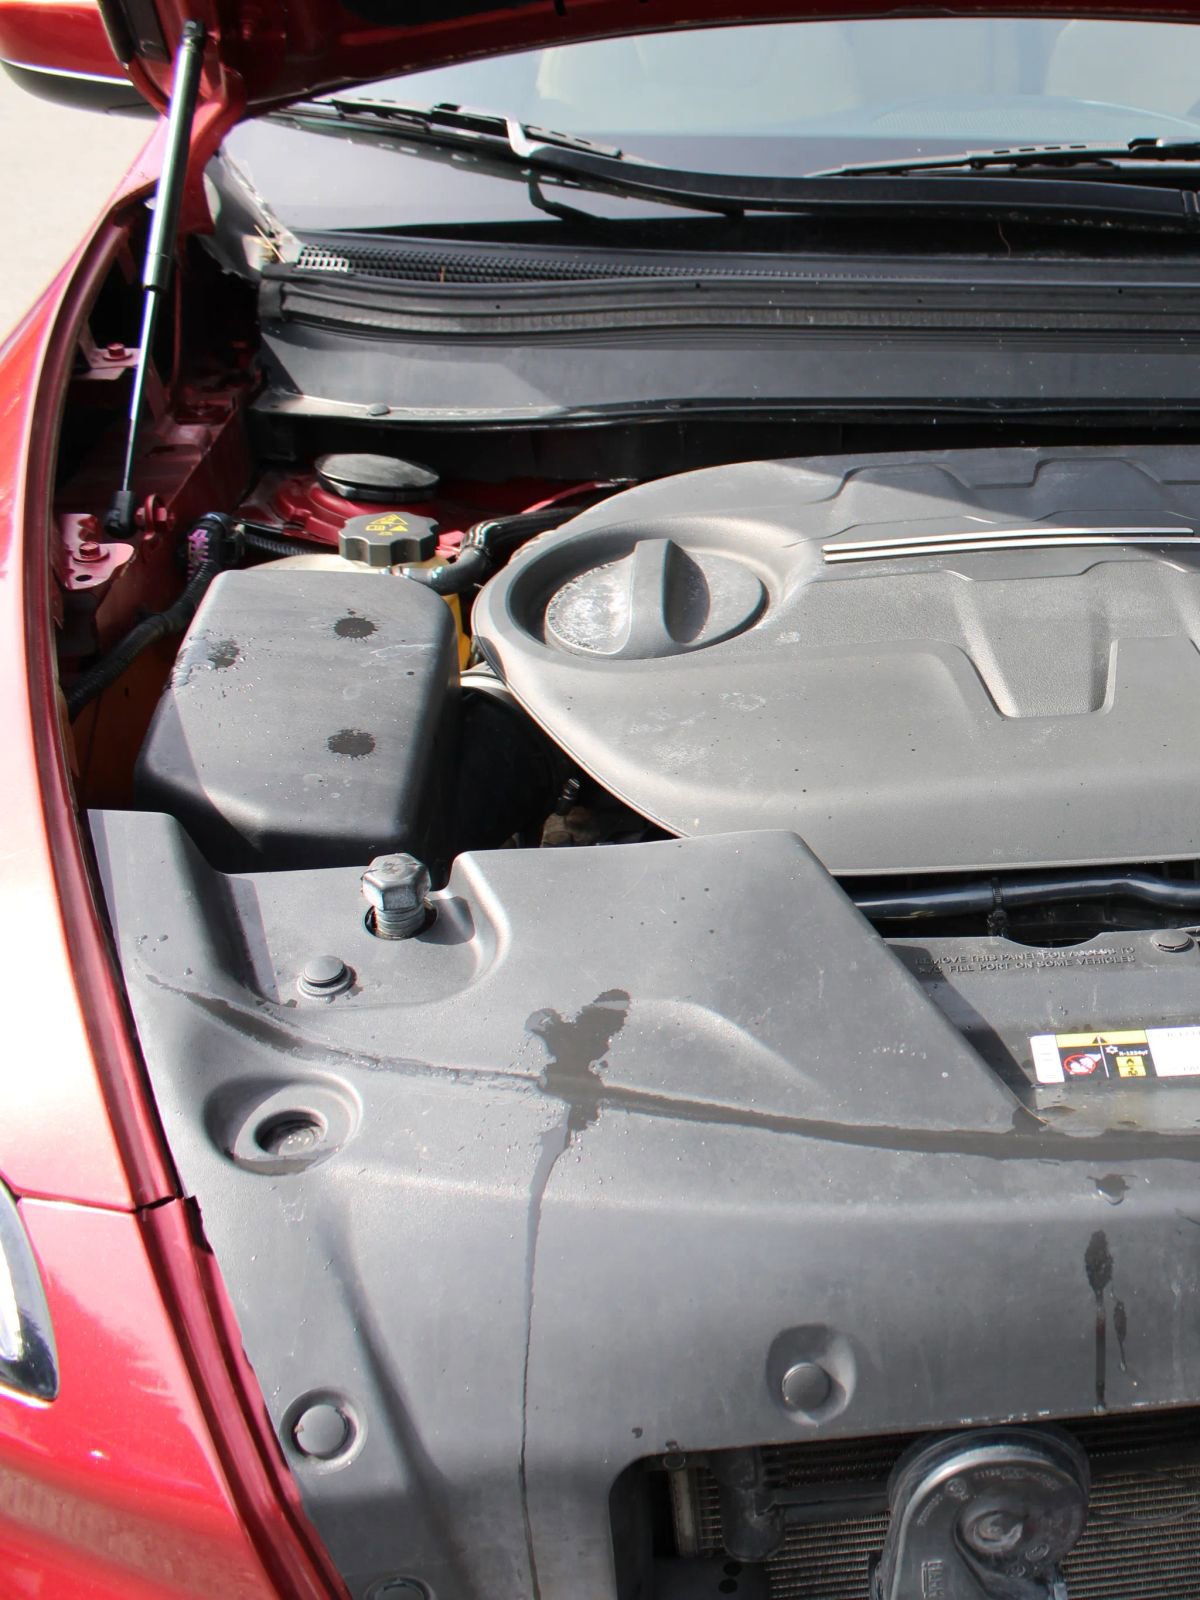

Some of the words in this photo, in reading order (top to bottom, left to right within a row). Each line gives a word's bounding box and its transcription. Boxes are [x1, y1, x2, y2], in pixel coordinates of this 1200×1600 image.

[950, 963, 975, 973] FILL
[980, 961, 1010, 971] PORT
[1037, 958, 1073, 968] SOME
[1077, 955, 1136, 966] VEHICLES
